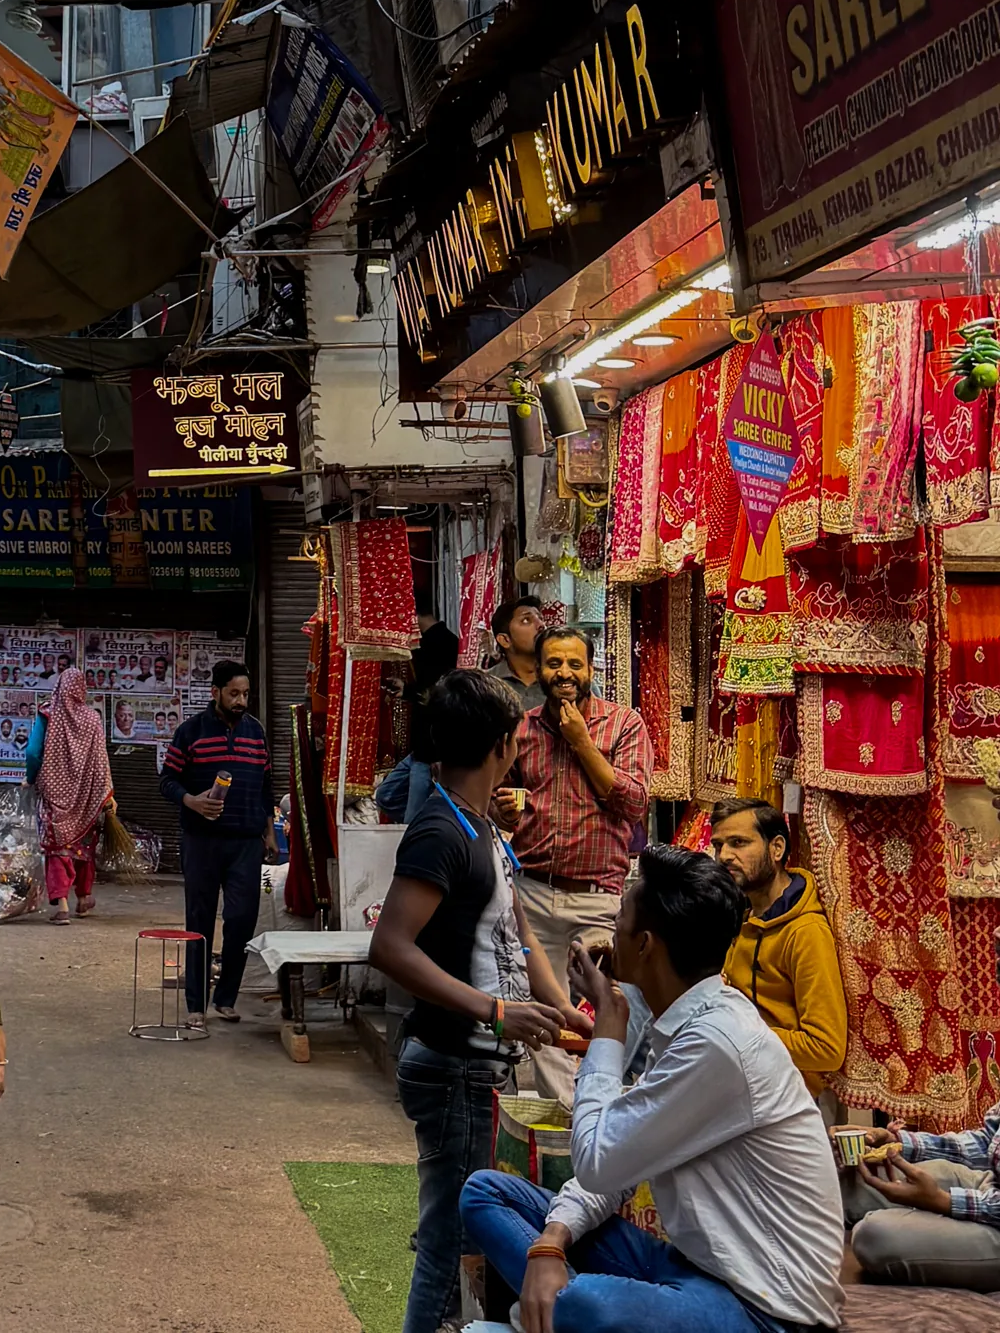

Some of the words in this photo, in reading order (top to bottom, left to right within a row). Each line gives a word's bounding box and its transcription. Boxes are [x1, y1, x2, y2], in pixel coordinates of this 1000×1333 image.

[545, 3, 660, 202] KUMAR
[772, 201, 822, 254] TIRAHA,
[825, 173, 876, 235] KINARI
[231, 372, 285, 402] मल
[742, 382, 786, 428] VICKY
[173, 415, 217, 448] बृज
[223, 405, 286, 441] मोहन
[733, 418, 760, 442] SAREE
[761, 427, 792, 451] CENTRE
[0, 465, 28, 499] OM
[187, 541, 232, 555] SAREES
[24, 566, 54, 577] Chowk,
[10, 637, 49, 649] विशाल
[51, 638, 72, 650] रैली
[105, 640, 145, 651] विशाल
[146, 640, 169, 652] रैली
